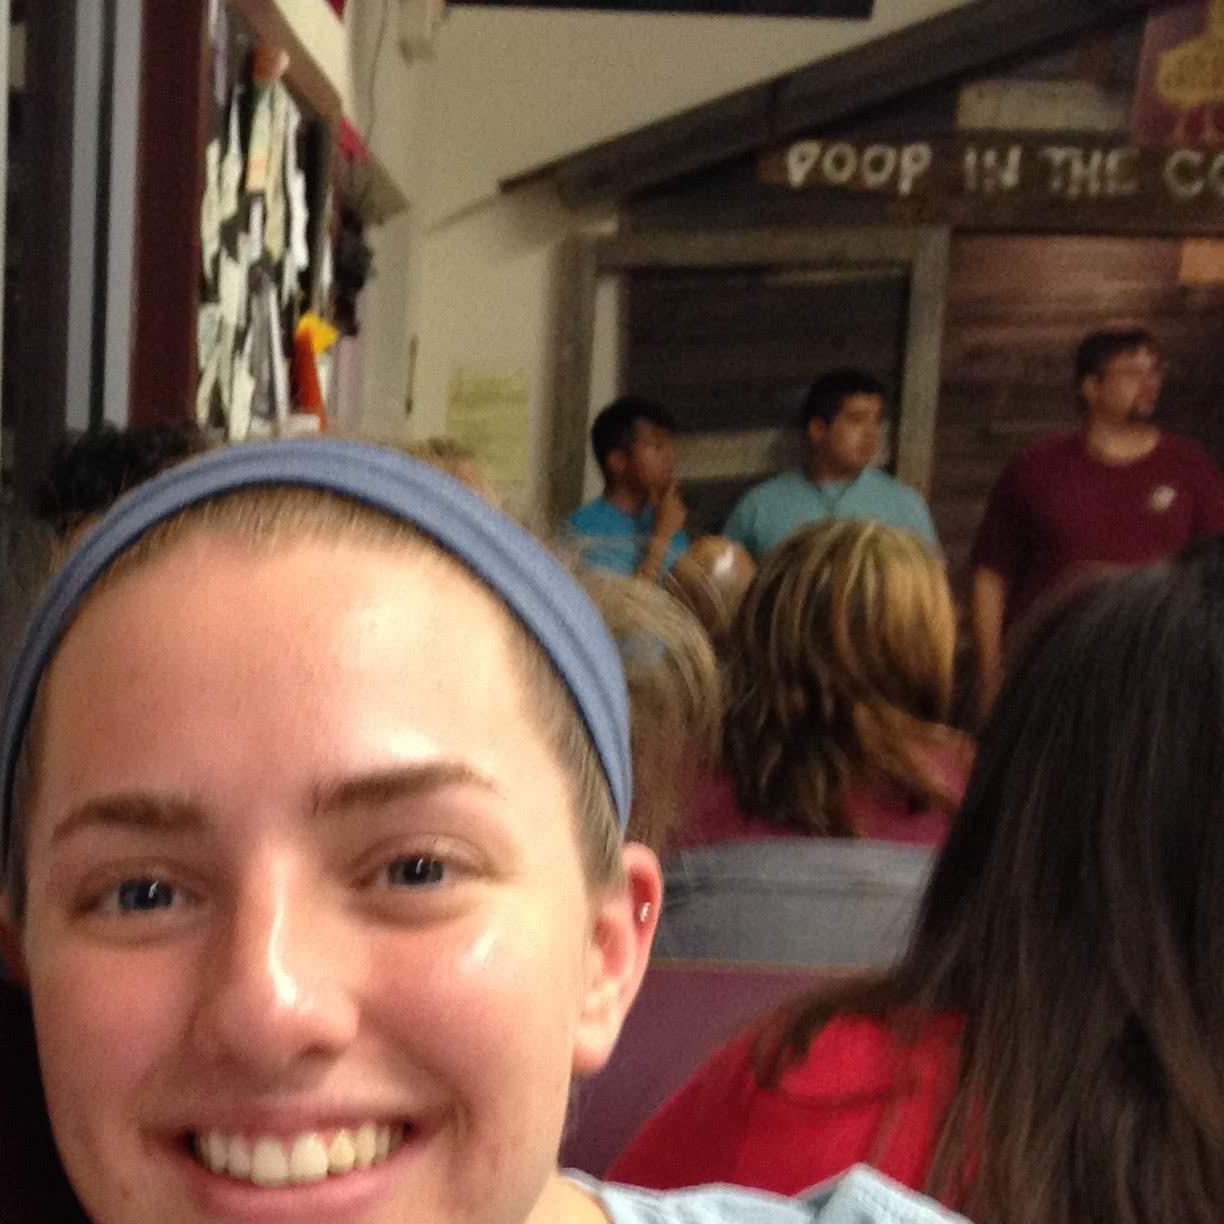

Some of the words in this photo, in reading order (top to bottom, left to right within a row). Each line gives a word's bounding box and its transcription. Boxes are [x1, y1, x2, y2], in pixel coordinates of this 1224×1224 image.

[785, 139, 932, 196] POOP
[963, 144, 1023, 194] IN
[1040, 146, 1142, 197] THE
